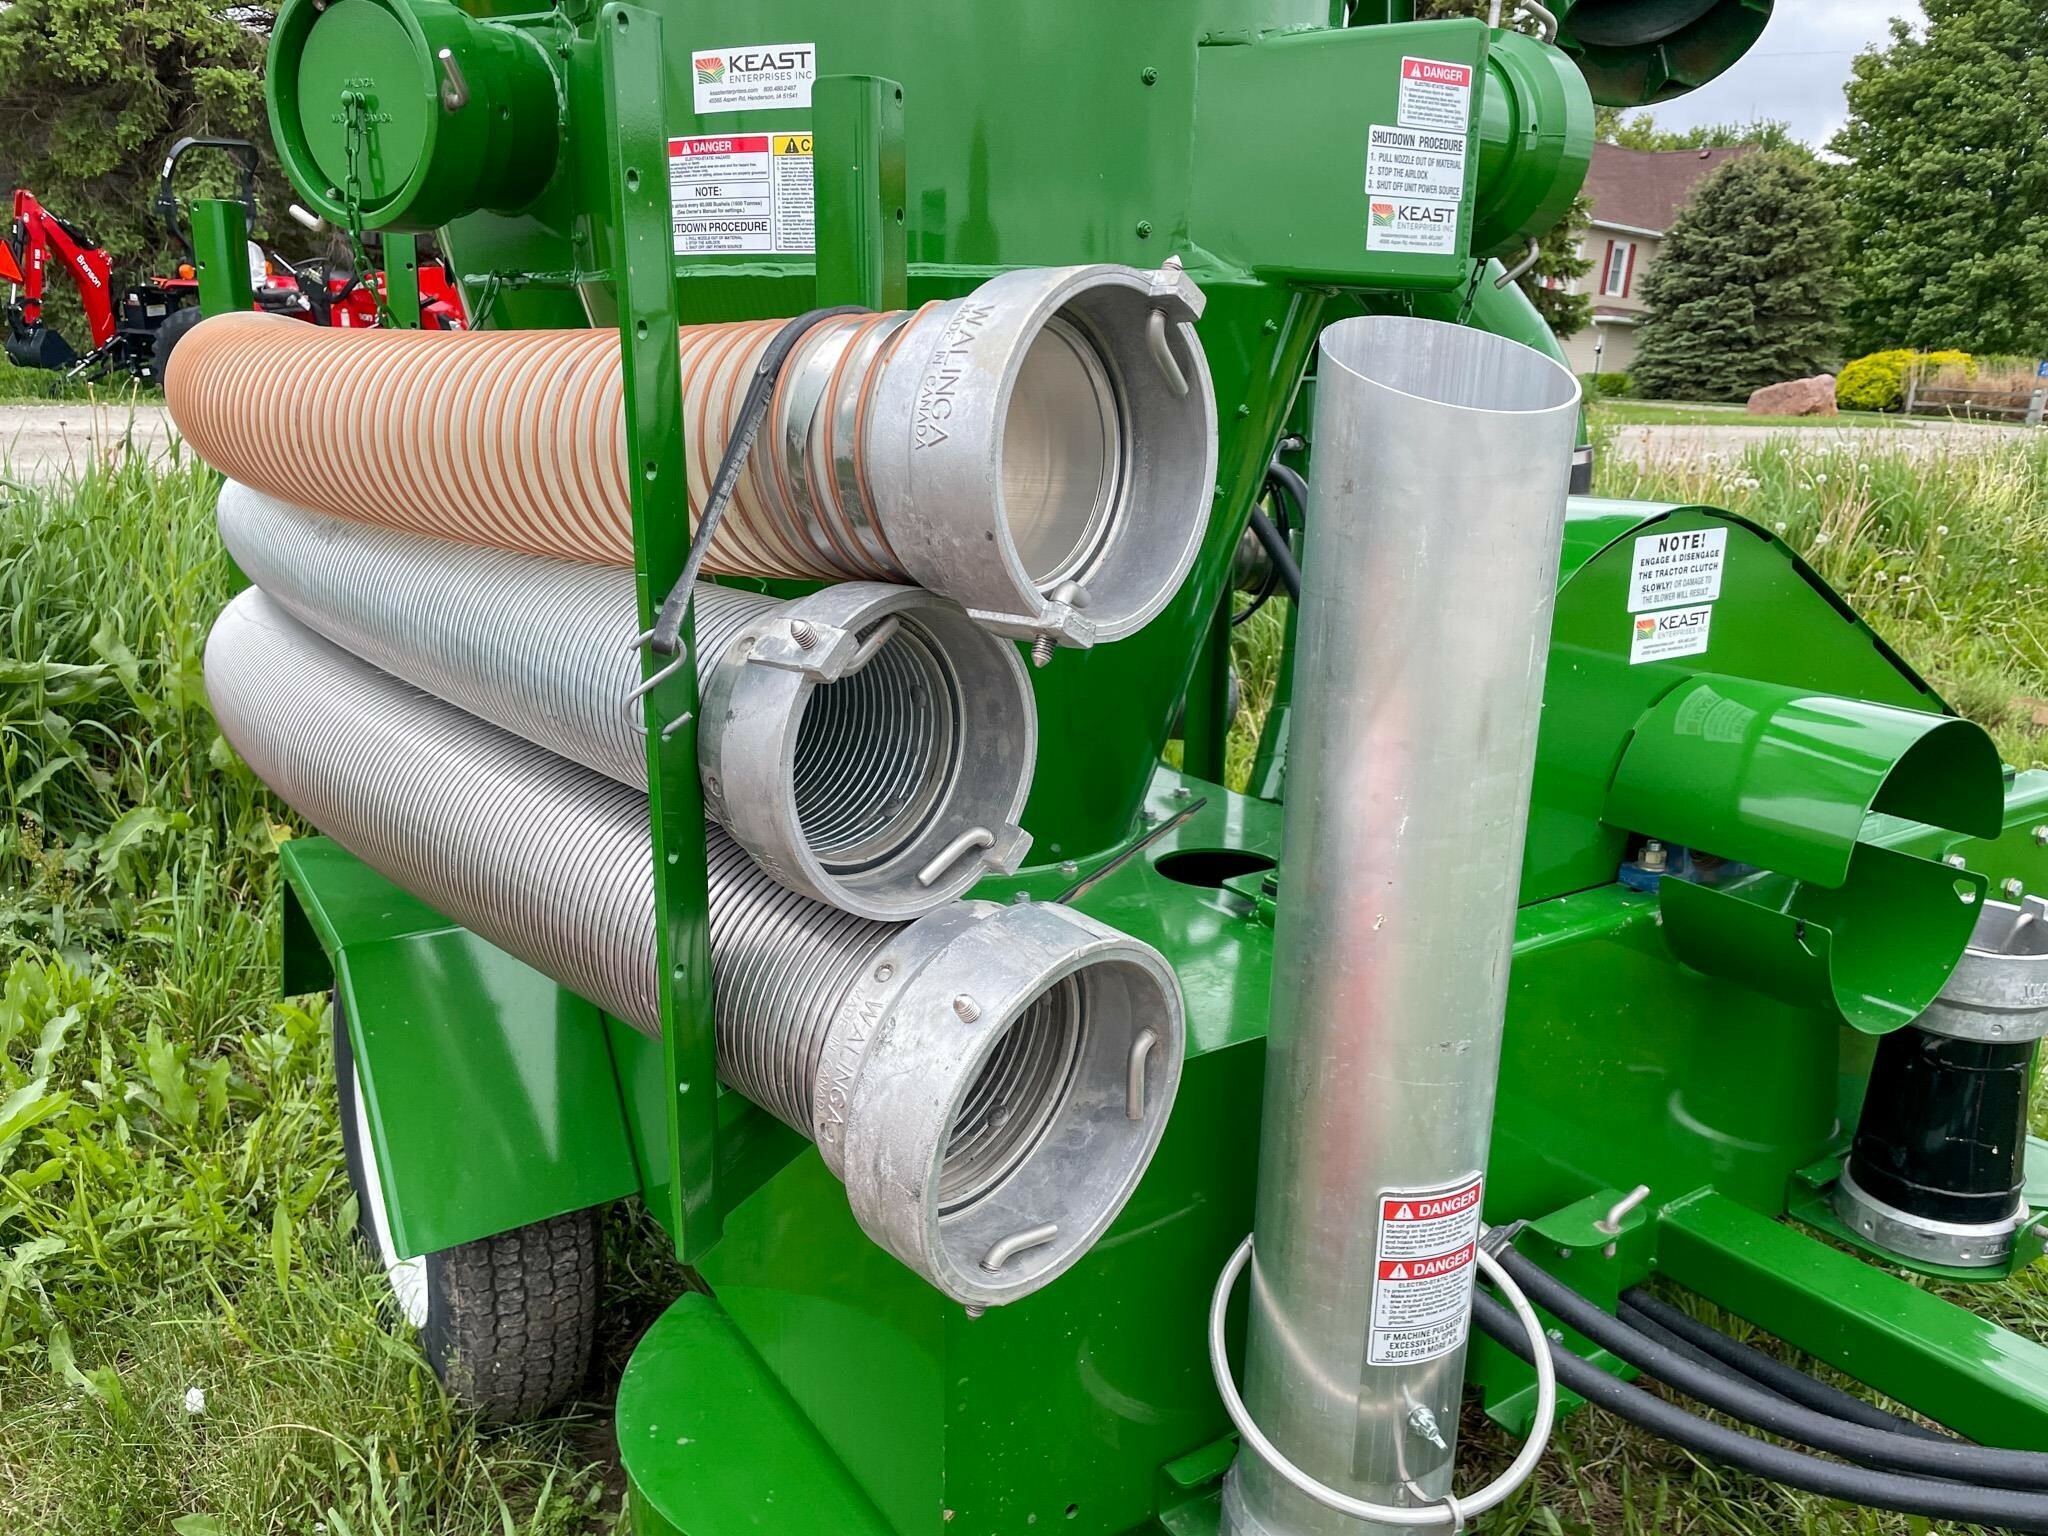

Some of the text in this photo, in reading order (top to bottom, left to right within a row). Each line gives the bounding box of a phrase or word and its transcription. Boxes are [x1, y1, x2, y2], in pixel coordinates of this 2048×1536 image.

[729, 51, 811, 73] KEAST
[730, 71, 812, 84] ENTERPRISES INC
[1424, 66, 1462, 82] DANGER
[693, 141, 732, 153] DANGER
[1372, 130, 1463, 152] SHUTDOWN PROCEDURE
[1378, 152, 1392, 162] PULL
[1394, 154, 1414, 164] NOZZLE
[1416, 156, 1427, 166] OUT
[1428, 158, 1434, 166] OF
[1436, 158, 1462, 170] MATERIAL
[1369, 166, 1429, 180] 2. STOP THE AIRLOCK
[696, 186, 722, 196] NOTE:
[1368, 179, 1460, 196] 3. SHUT OFF UNIT POWER SOURCE
[1398, 205, 1455, 224] KEAST
[708, 222, 768, 232] PROCEDURE
[1396, 222, 1440, 232] ENTERPRISES
[76, 254, 101, 288] Branson
[915, 302, 974, 450] MADE IN CANADA
[1658, 533, 1706, 552] NOTE!
[1640, 550, 1720, 566] ENGAGE & DISENGAGE
[1638, 562, 1718, 580] THE TRACTOR CLUTCH
[1674, 580, 1682, 588] OR
[1683, 576, 1704, 586] DAMAGE
[1706, 576, 1712, 584] TO
[1642, 587, 1709, 605] THE BLOWER WILL RESULT
[1658, 611, 1708, 630] KEAST
[827, 1000, 884, 1124] WALINGA
[1418, 1190, 1476, 1216] DANGER
[1413, 1248, 1470, 1276] DANGER
[1398, 1274, 1448, 1288] ELECTRO-STATIC
[1392, 1329, 1430, 1340] MACHINE
[1442, 1328, 1457, 1340] OPEN
[1385, 1350, 1408, 1358] SLIDE
[1410, 1348, 1426, 1357] FOR
[1426, 1342, 1447, 1354] MORE
